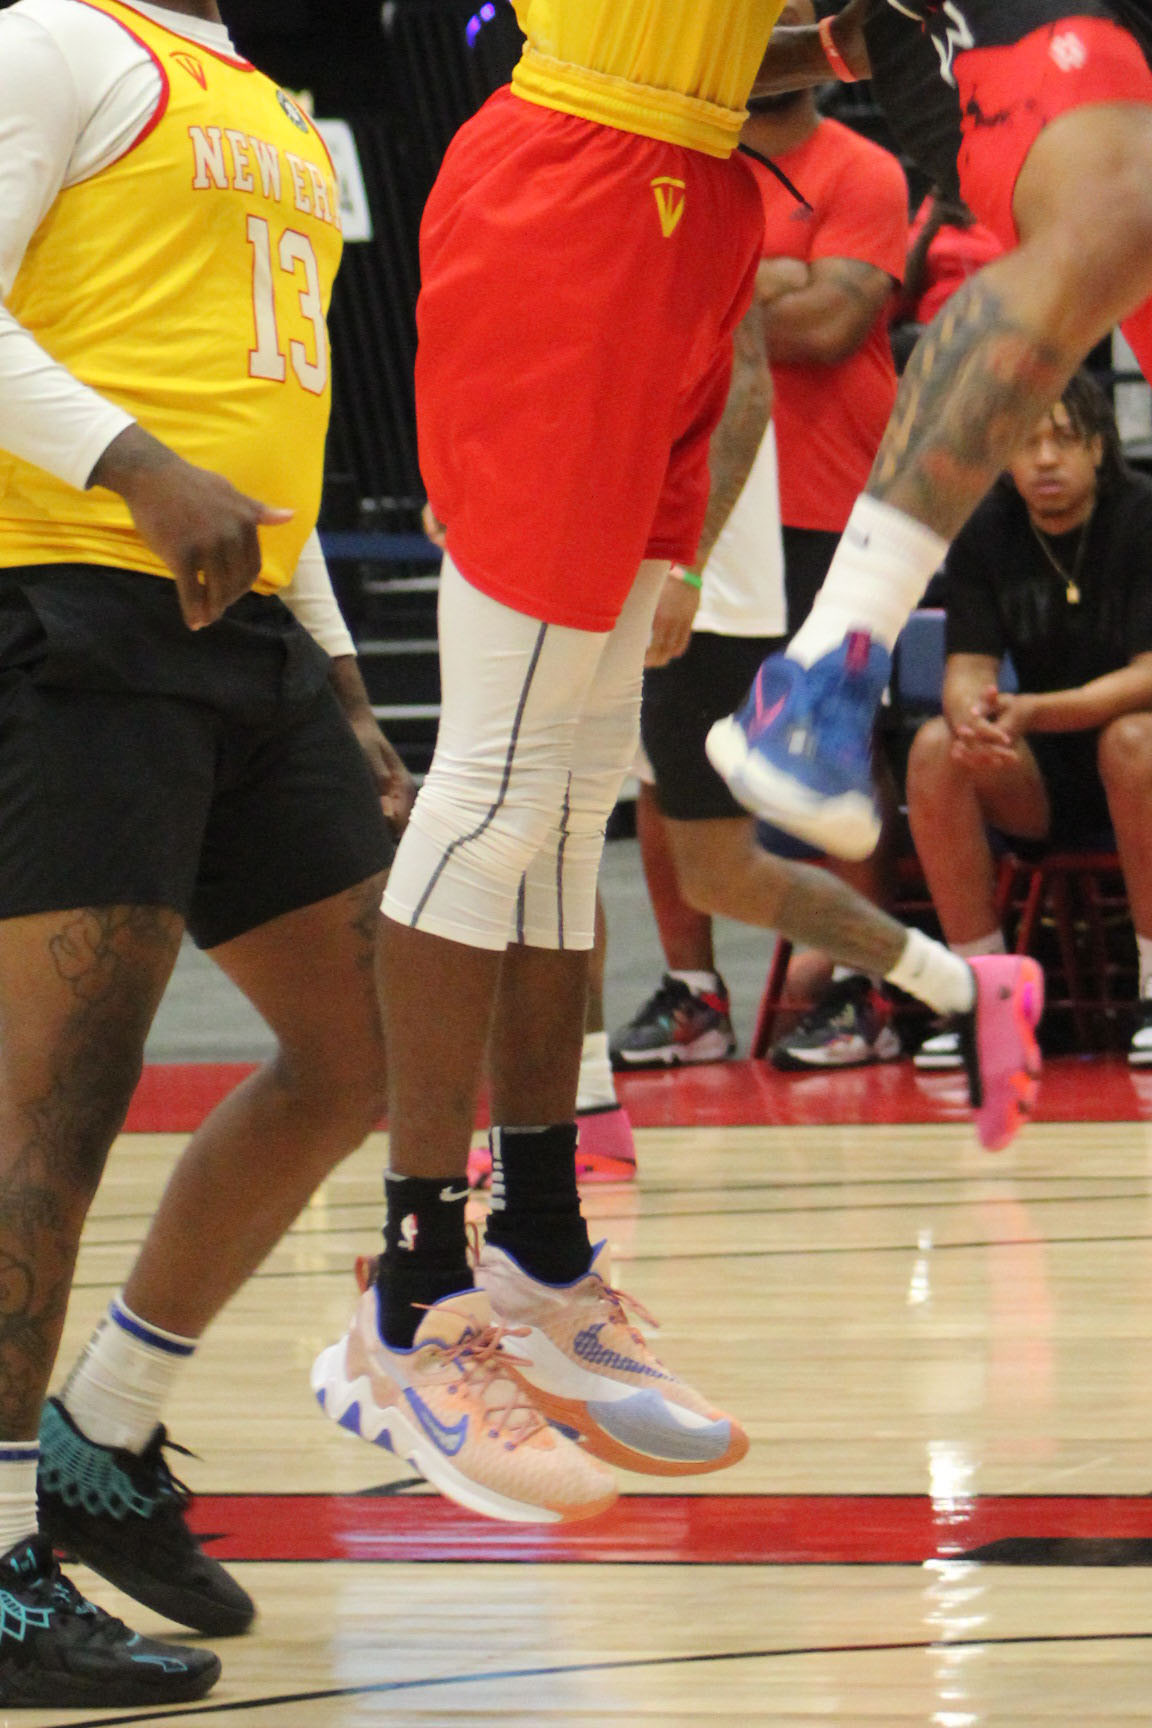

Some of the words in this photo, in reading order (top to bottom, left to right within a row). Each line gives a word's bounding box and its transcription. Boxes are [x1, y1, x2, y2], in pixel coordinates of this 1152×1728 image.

[187, 125, 282, 203] NEW
[283, 150, 343, 233] ER
[246, 213, 329, 397] 13
